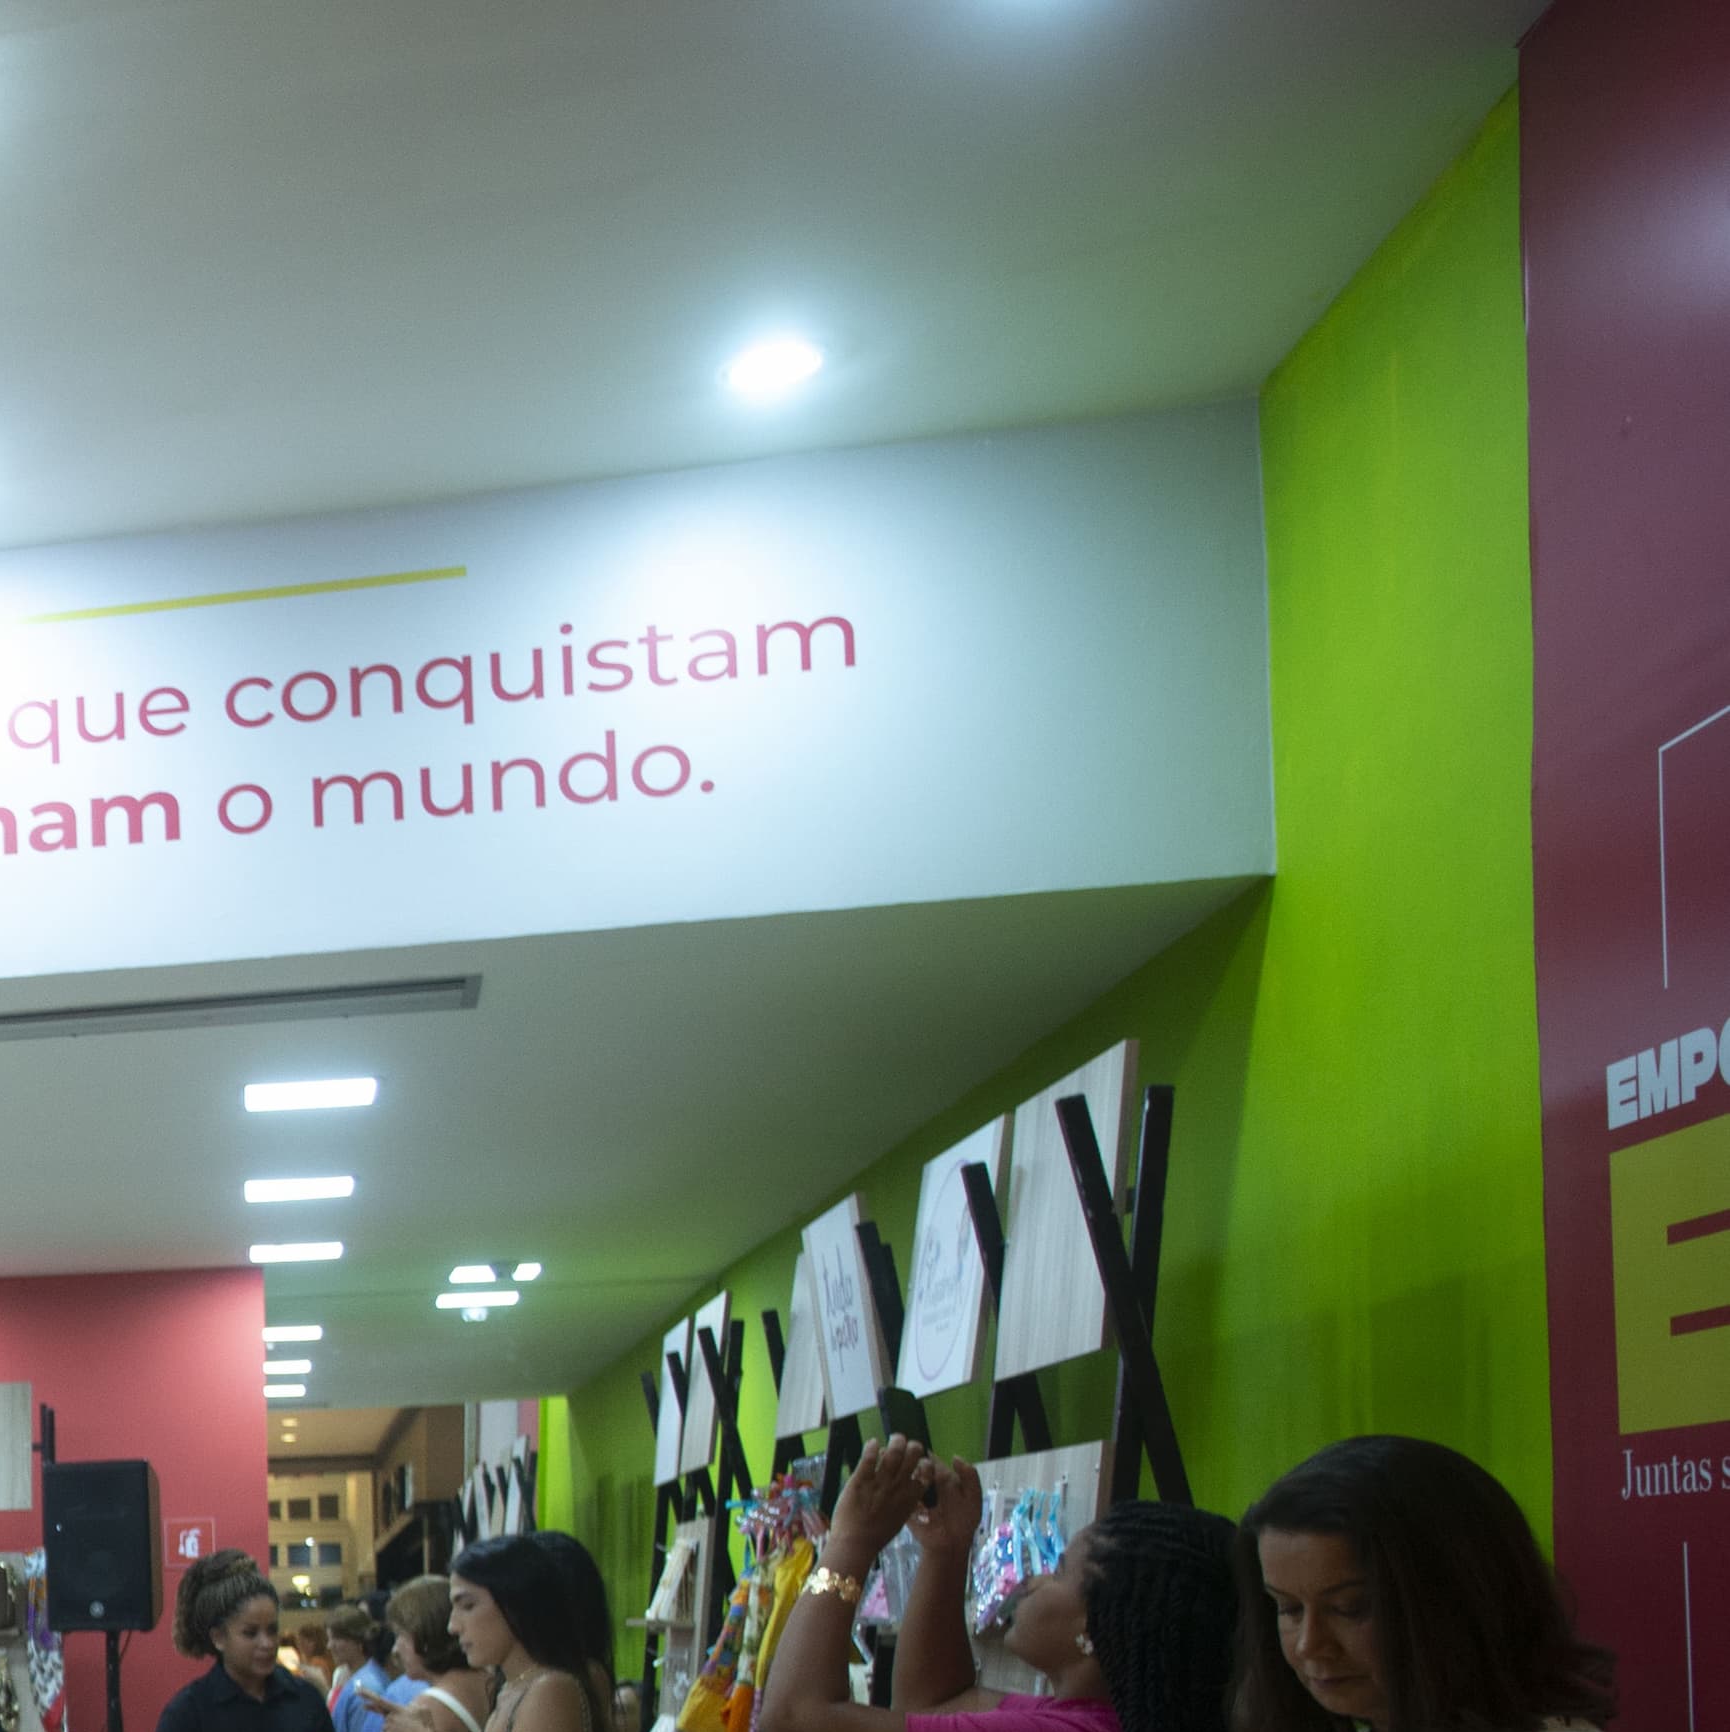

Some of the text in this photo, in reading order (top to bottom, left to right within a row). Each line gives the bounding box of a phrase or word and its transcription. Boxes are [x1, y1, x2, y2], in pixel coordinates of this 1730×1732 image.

[6, 685, 191, 765] que
[224, 613, 857, 729] conquistam
[216, 782, 274, 835] o
[311, 729, 716, 829] mundo.
[1606, 1016, 1730, 1131] EMP
[1620, 1448, 1713, 1501] Juntas
